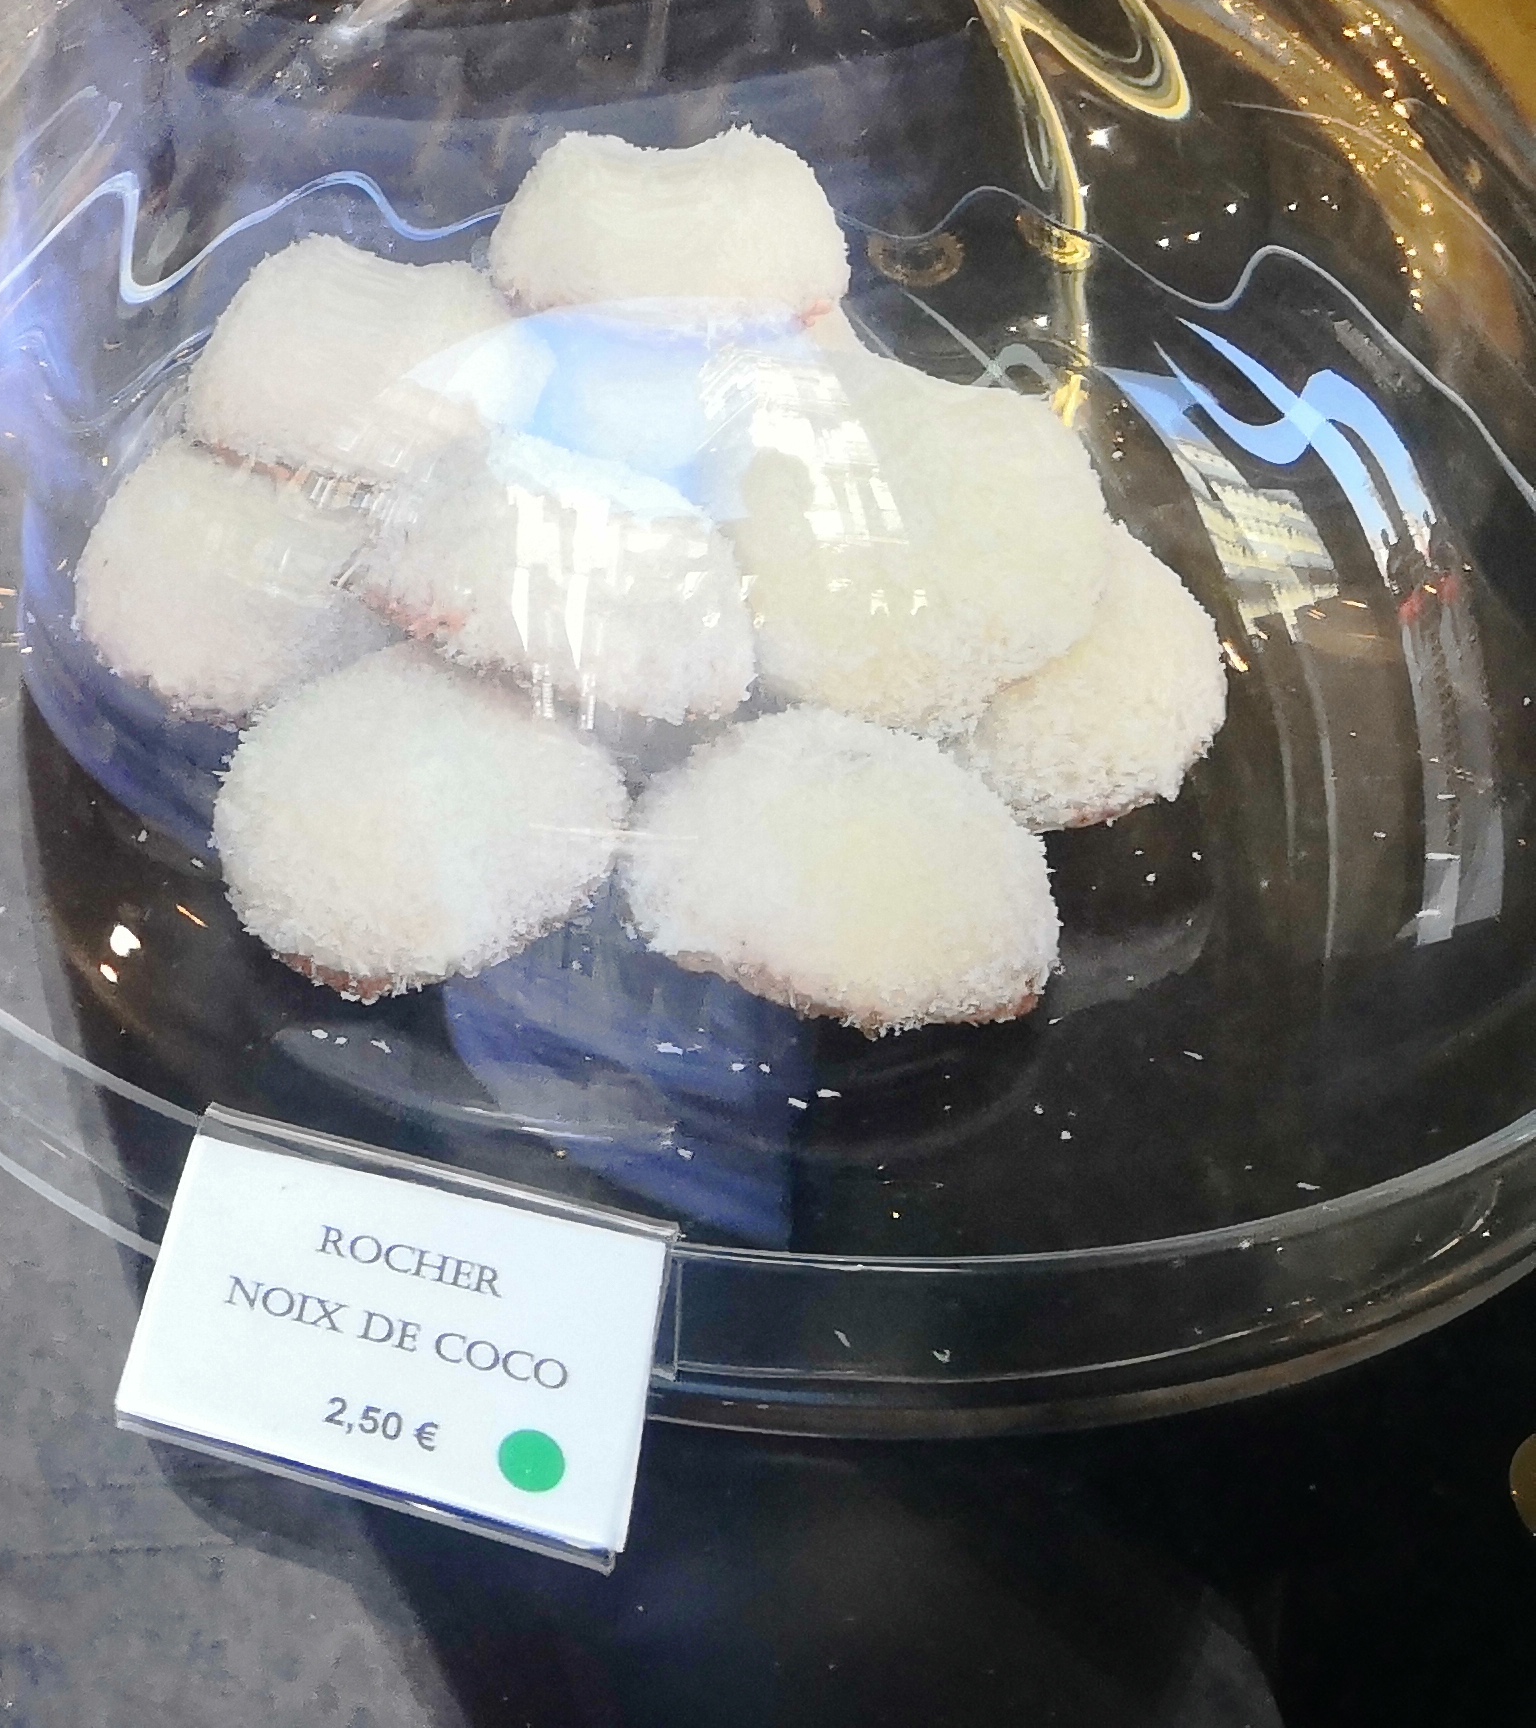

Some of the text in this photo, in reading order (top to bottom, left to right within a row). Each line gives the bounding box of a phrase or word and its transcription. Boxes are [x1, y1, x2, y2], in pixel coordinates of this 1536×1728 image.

[316, 1224, 502, 1298] ROCHER
[224, 1275, 569, 1390] NOIX DE COCO
[323, 1396, 440, 1452] 2,50 €
